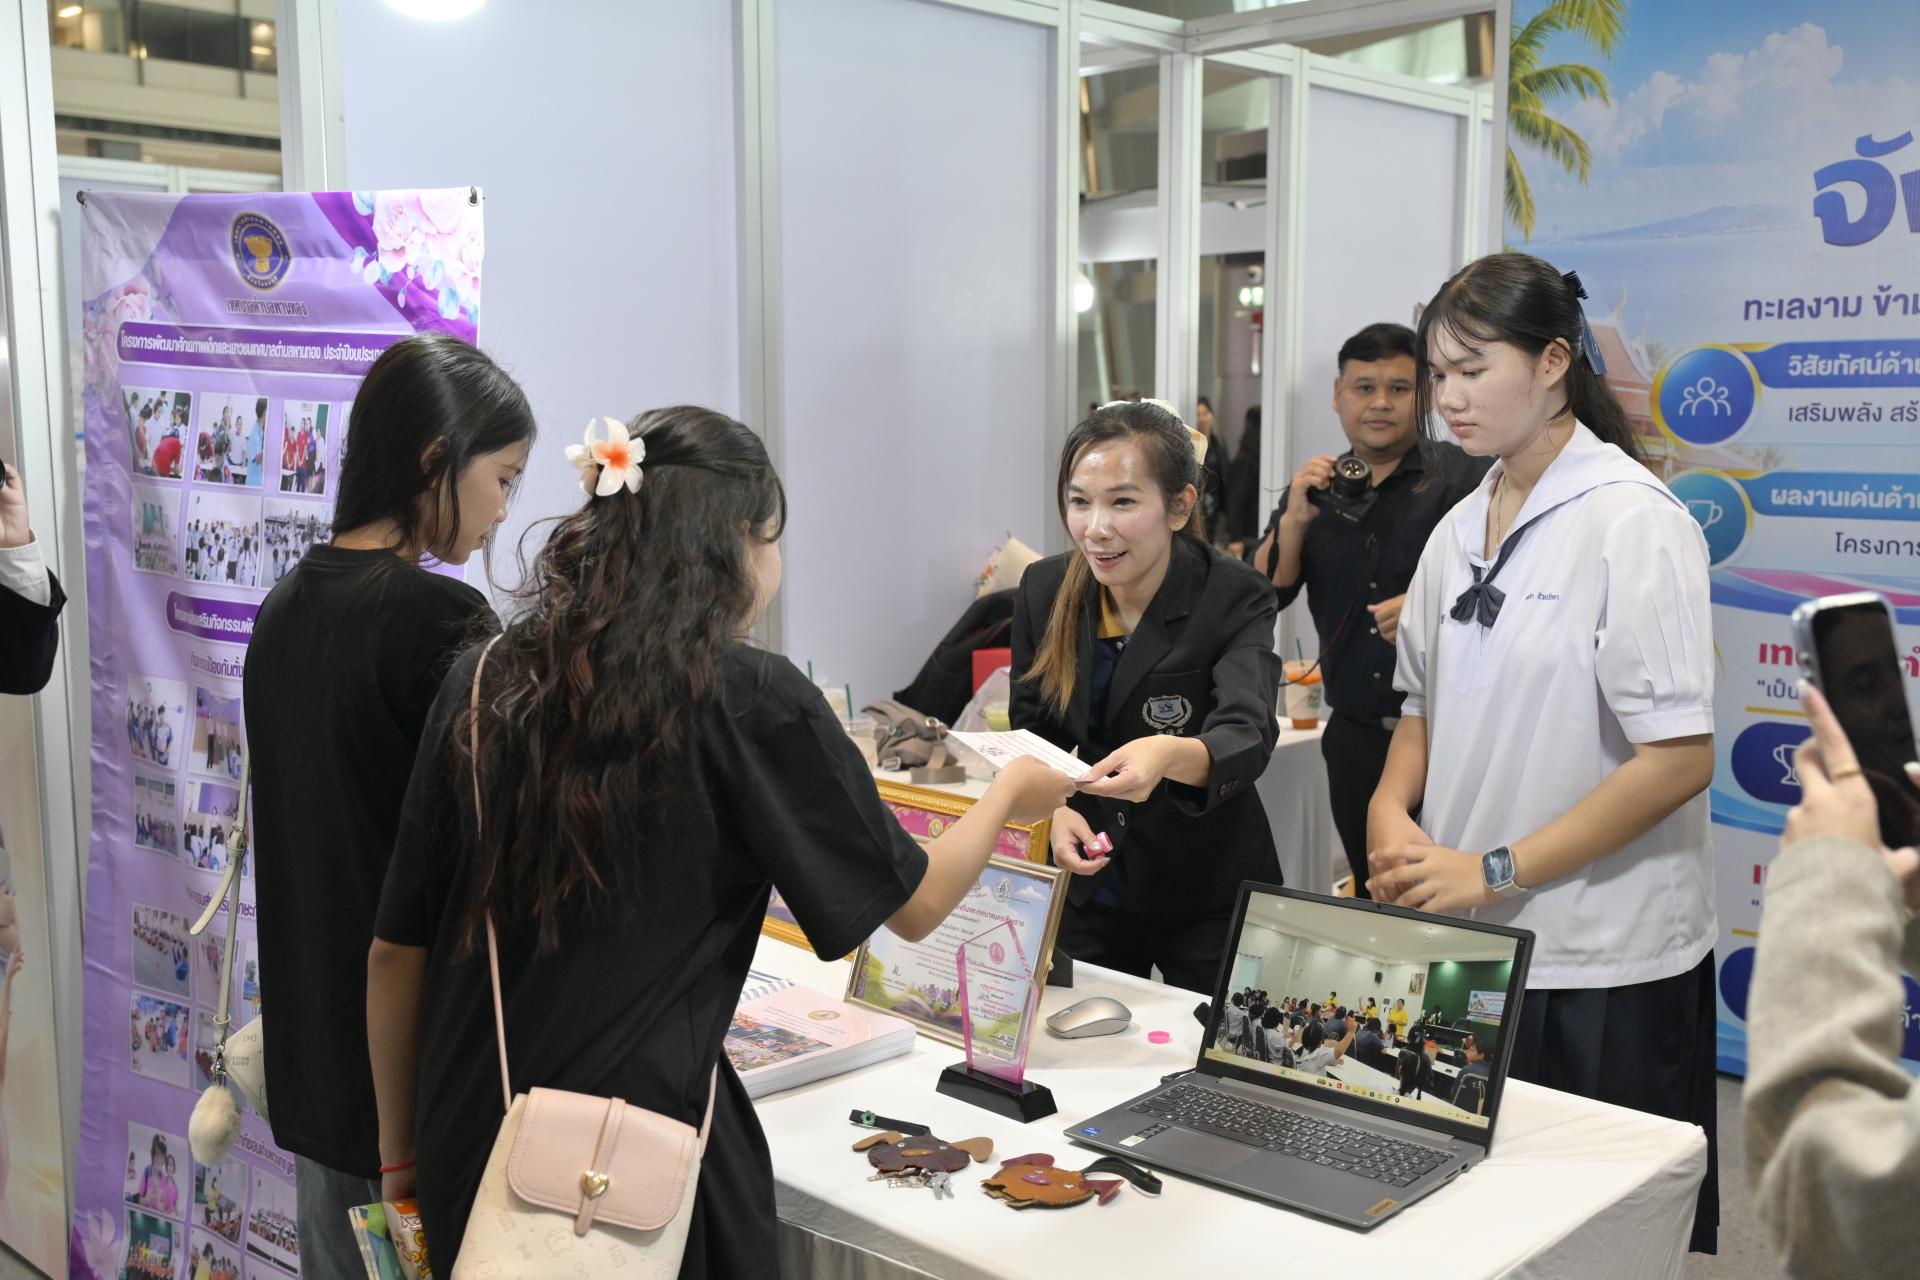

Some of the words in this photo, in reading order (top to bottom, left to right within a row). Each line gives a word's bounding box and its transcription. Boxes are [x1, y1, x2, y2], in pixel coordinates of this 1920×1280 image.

[1744, 296, 1862, 320] ทะเลงาม
[1873, 285, 1920, 316] ข้า
[1788, 351, 1920, 376] วิสัยทัศน์ด้า
[1789, 402, 1883, 423] เสริมพลัง
[1771, 484, 1920, 509] ผลงานเด่นด้า
